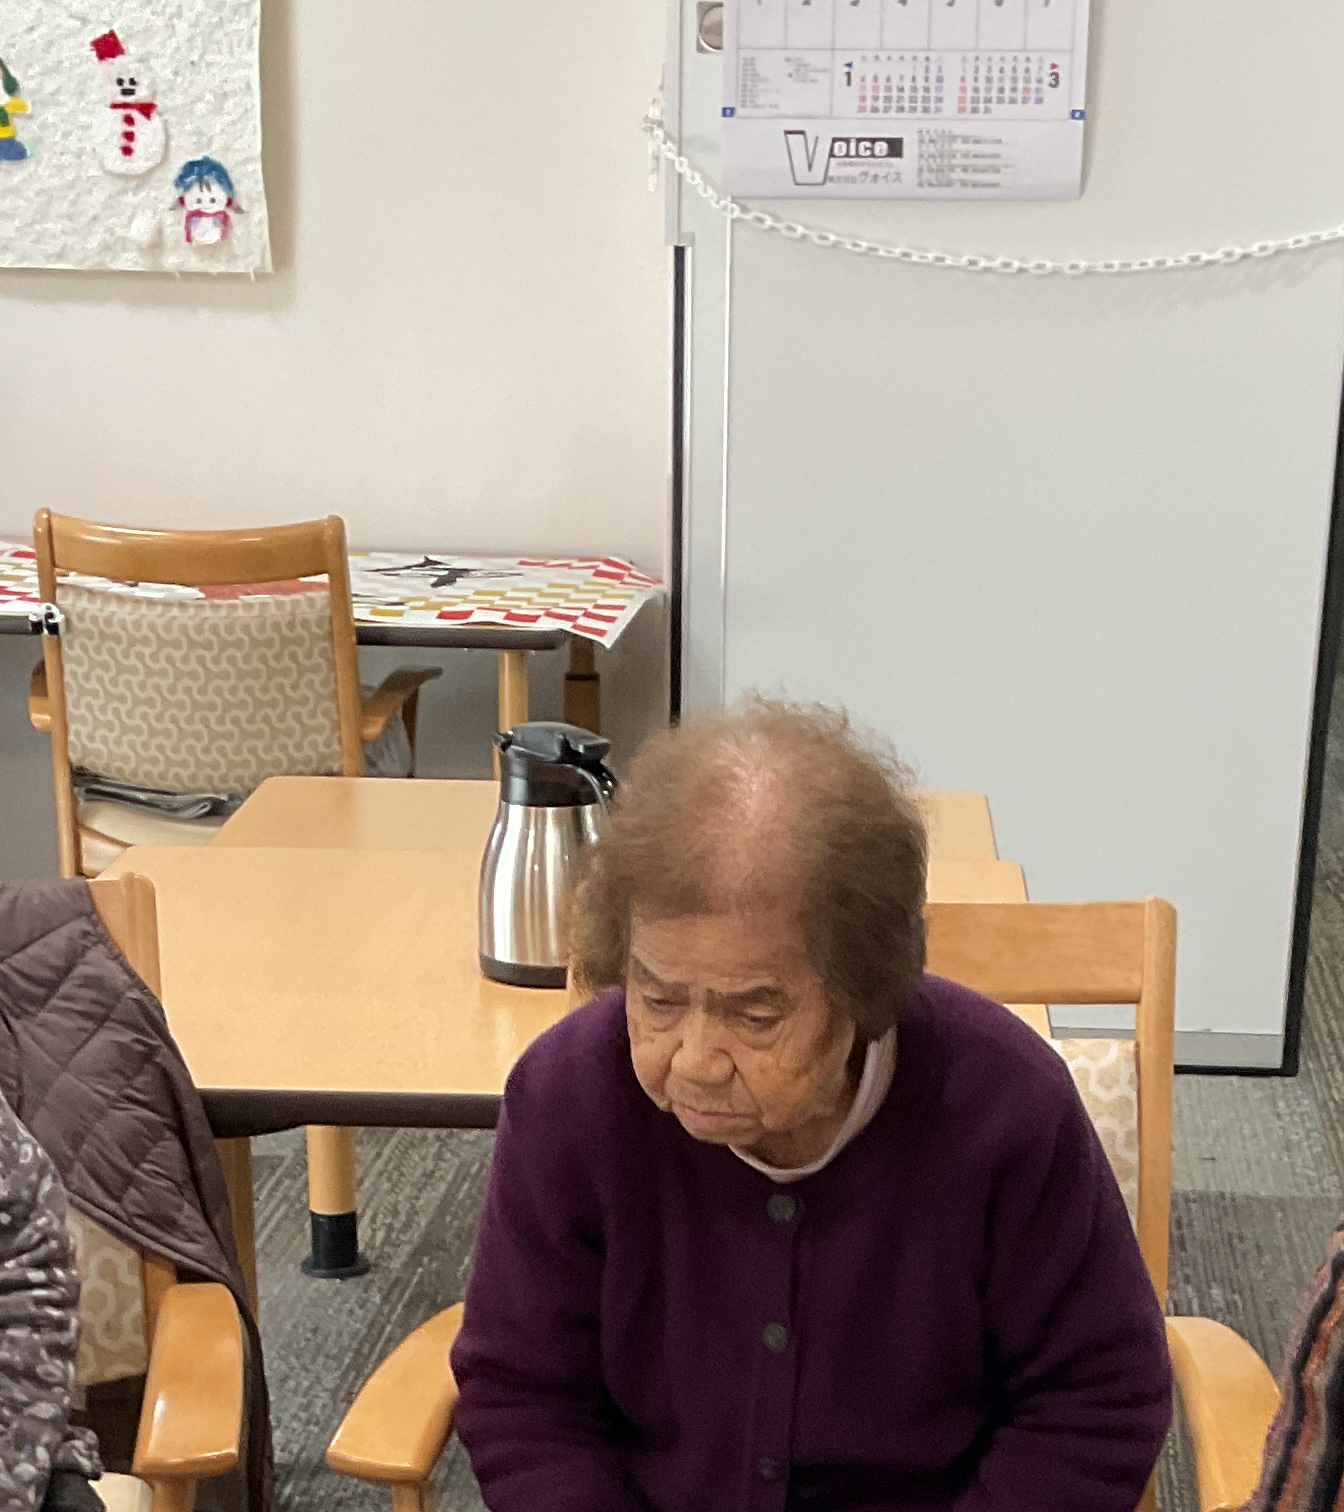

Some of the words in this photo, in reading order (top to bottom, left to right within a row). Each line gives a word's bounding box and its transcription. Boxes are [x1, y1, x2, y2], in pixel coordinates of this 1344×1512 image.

[844, 71, 852, 87] 1
[1048, 71, 1060, 88] 3
[783, 129, 890, 186] Voice
